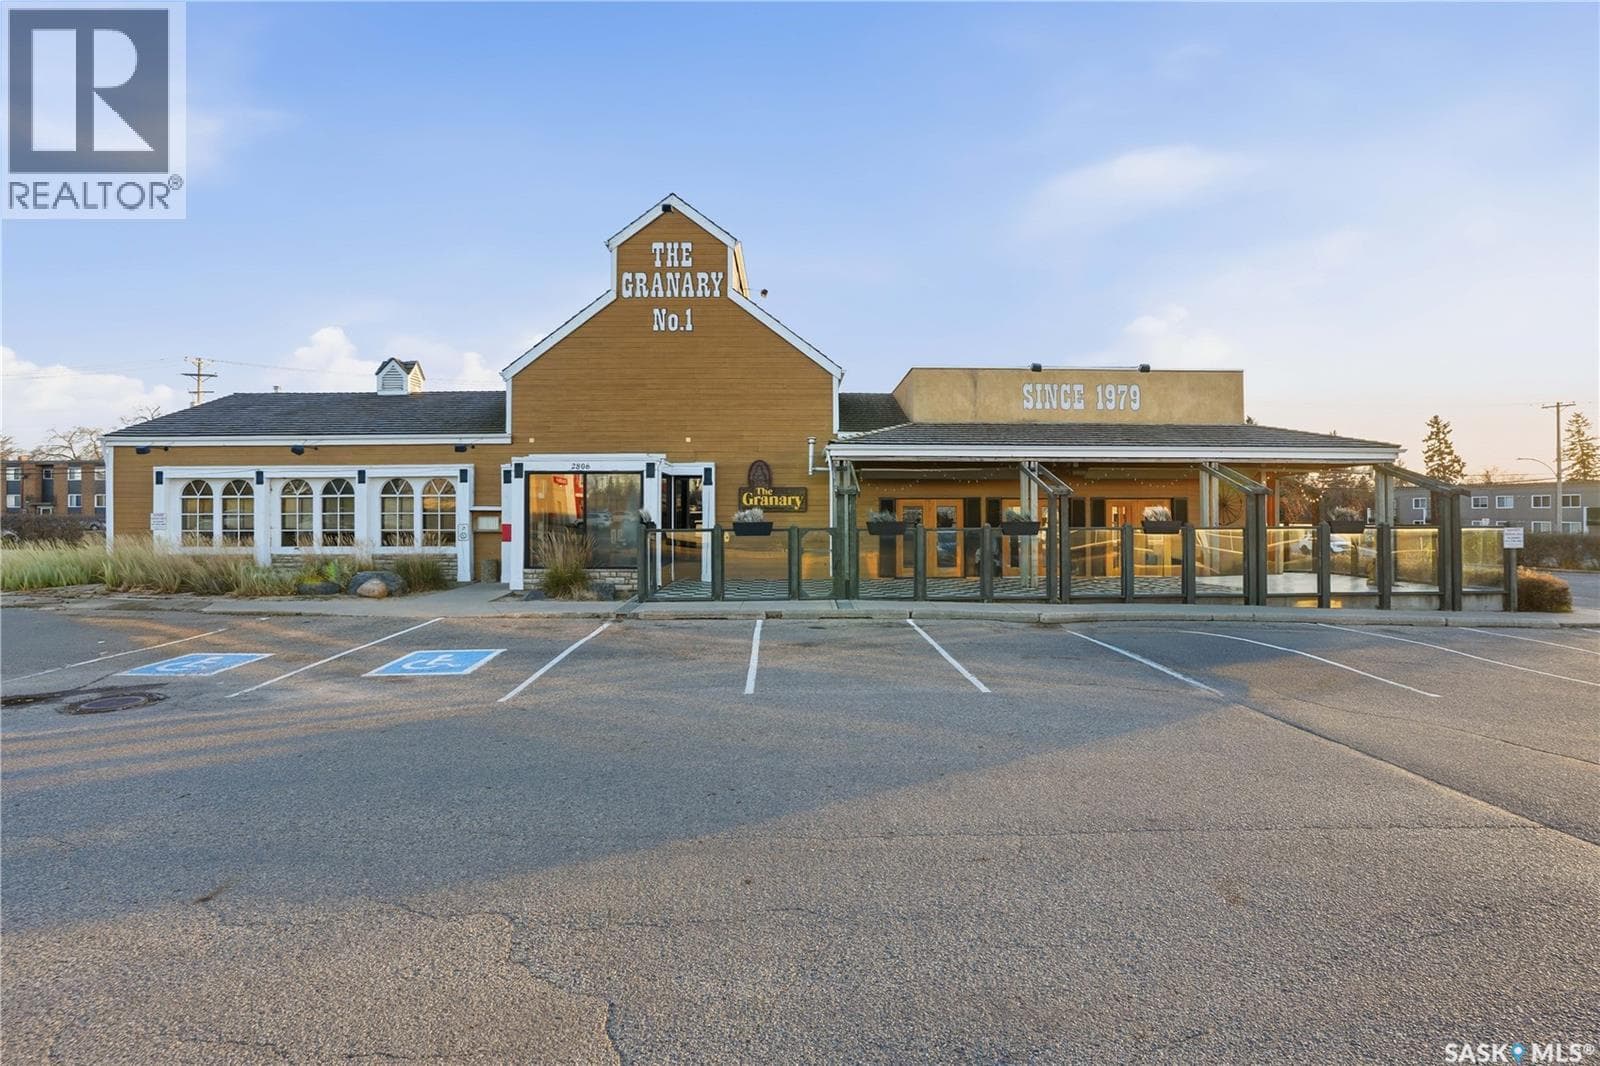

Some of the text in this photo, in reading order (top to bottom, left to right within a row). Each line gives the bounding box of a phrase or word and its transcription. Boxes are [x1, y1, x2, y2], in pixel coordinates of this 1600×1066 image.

[651, 241, 693, 268] THE
[621, 271, 724, 299] GRANARY
[652, 307, 694, 332] No.1
[1022, 383, 1141, 411] SINCE 1979
[571, 462, 591, 470] 2806
[742, 491, 804, 510] Granary
[756, 487, 774, 496] The
